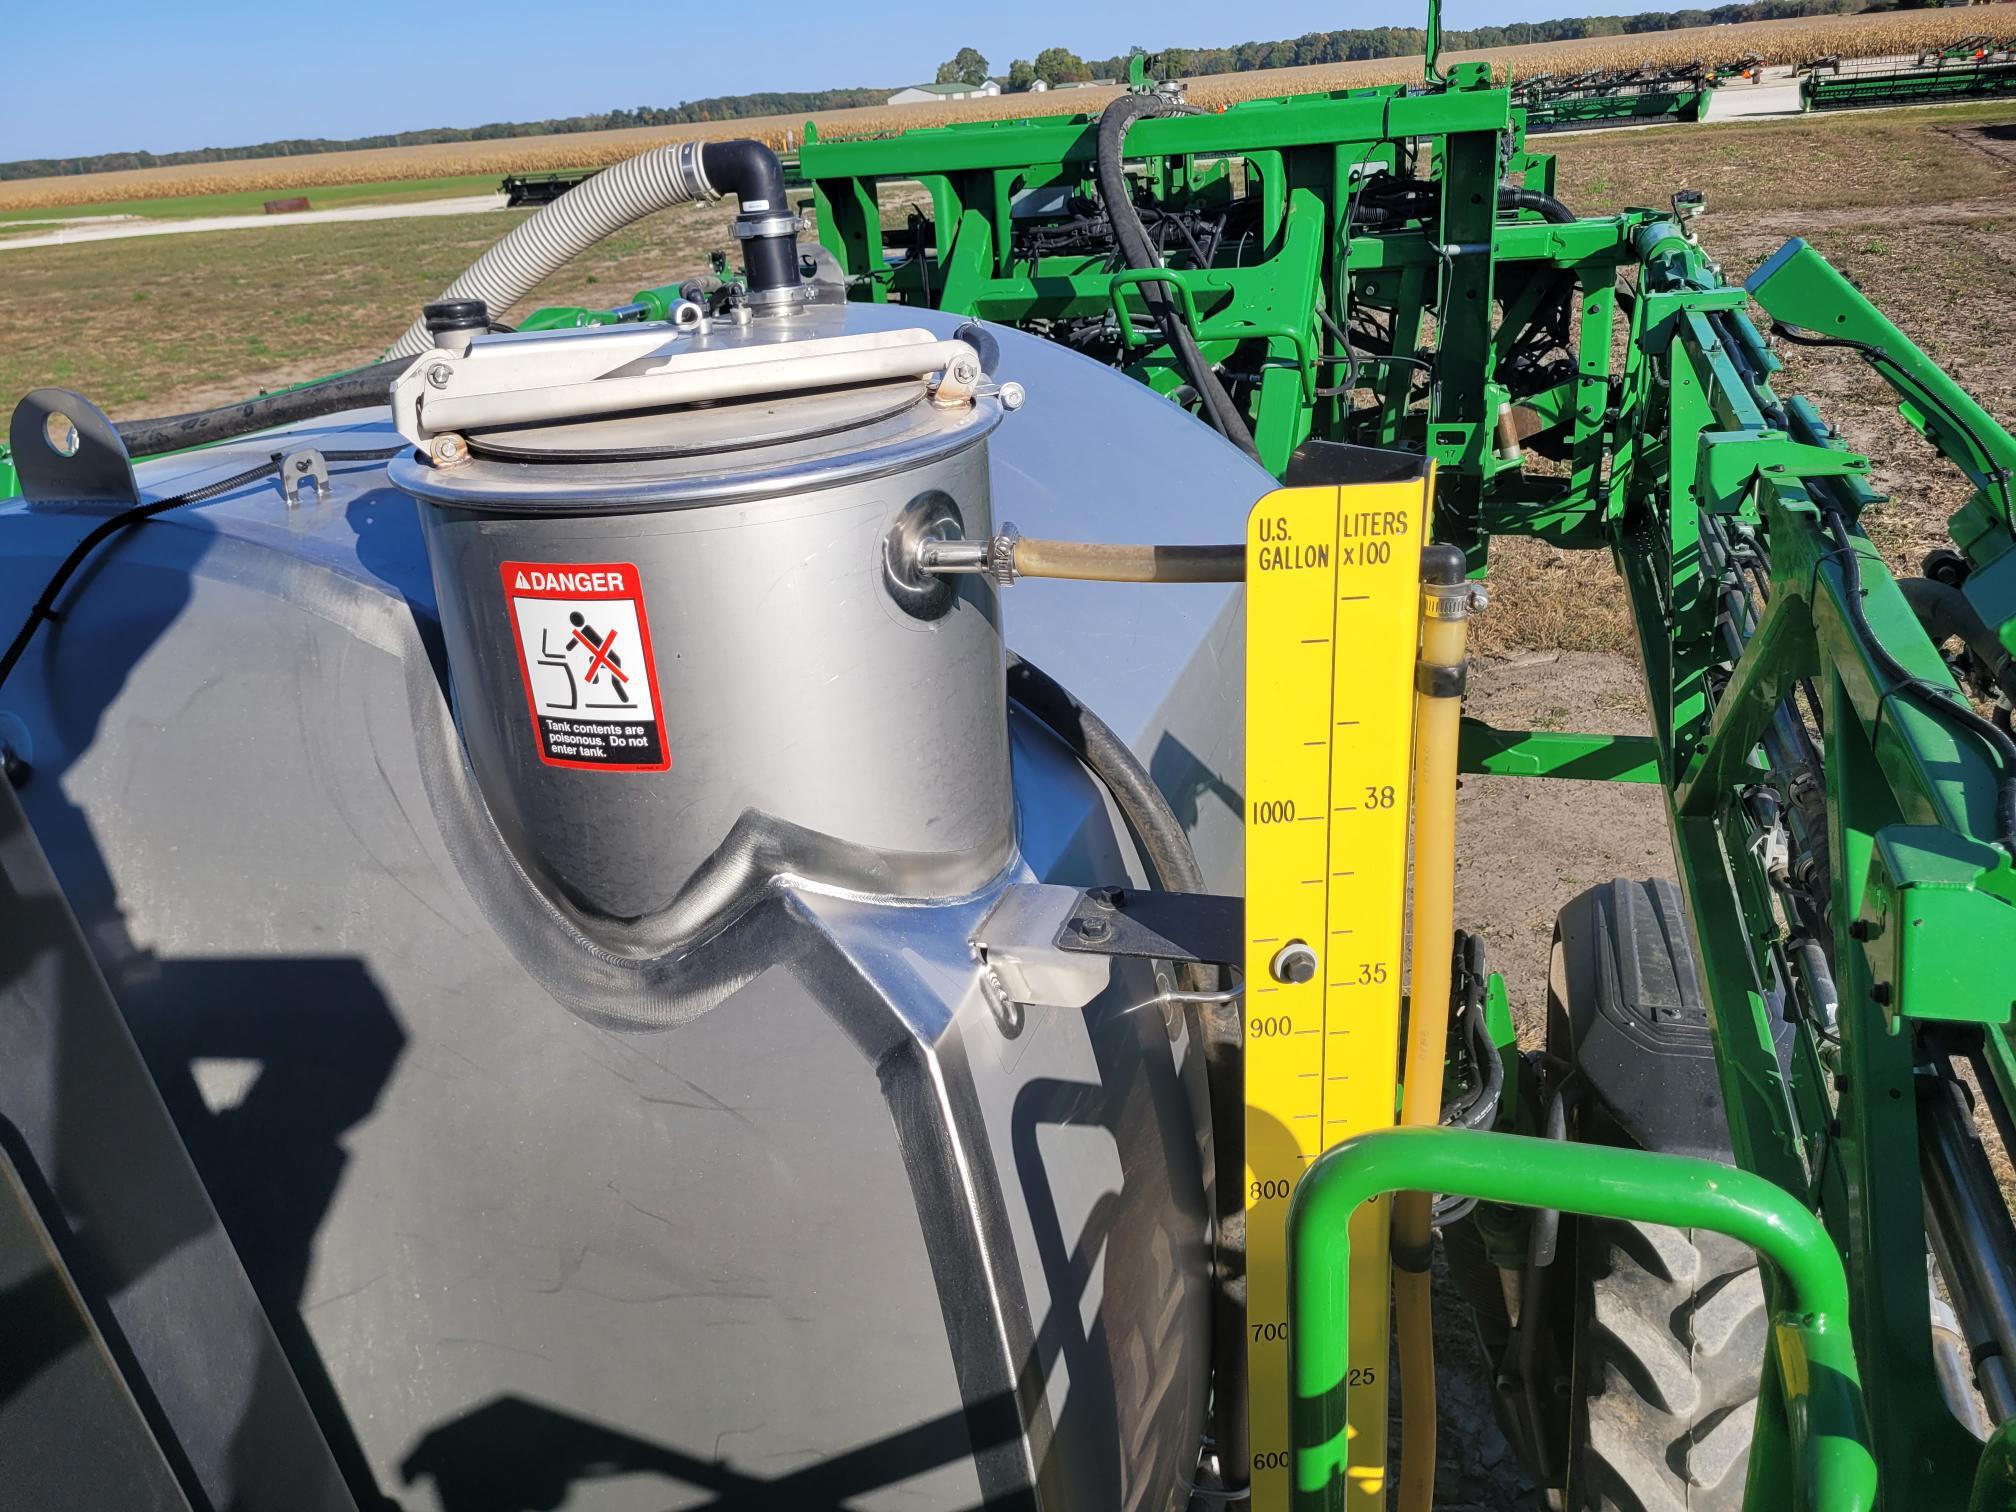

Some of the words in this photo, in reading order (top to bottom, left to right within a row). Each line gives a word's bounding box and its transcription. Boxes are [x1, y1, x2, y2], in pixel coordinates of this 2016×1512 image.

[1259, 517, 1292, 542] U.S.
[1343, 511, 1408, 538] LITERS
[1259, 544, 1330, 570] GALLON
[530, 572, 625, 592] DANGER
[546, 720, 571, 733] Tank
[573, 724, 622, 735] contents
[625, 726, 644, 735] are
[549, 732, 605, 746] poisonous.
[610, 736, 626, 747] Do
[629, 737, 649, 747] not
[551, 744, 578, 756] enter
[579, 746, 607, 758] tank.
[1364, 785, 1396, 810] 38
[1253, 799, 1295, 825] 1000
[1358, 962, 1387, 986] 35
[1250, 1015, 1292, 1038] 900
[1250, 1179, 1290, 1200] 800
[1251, 1323, 1288, 1343] 700
[1349, 1367, 1375, 1387] 25
[1253, 1451, 1289, 1470] 600
